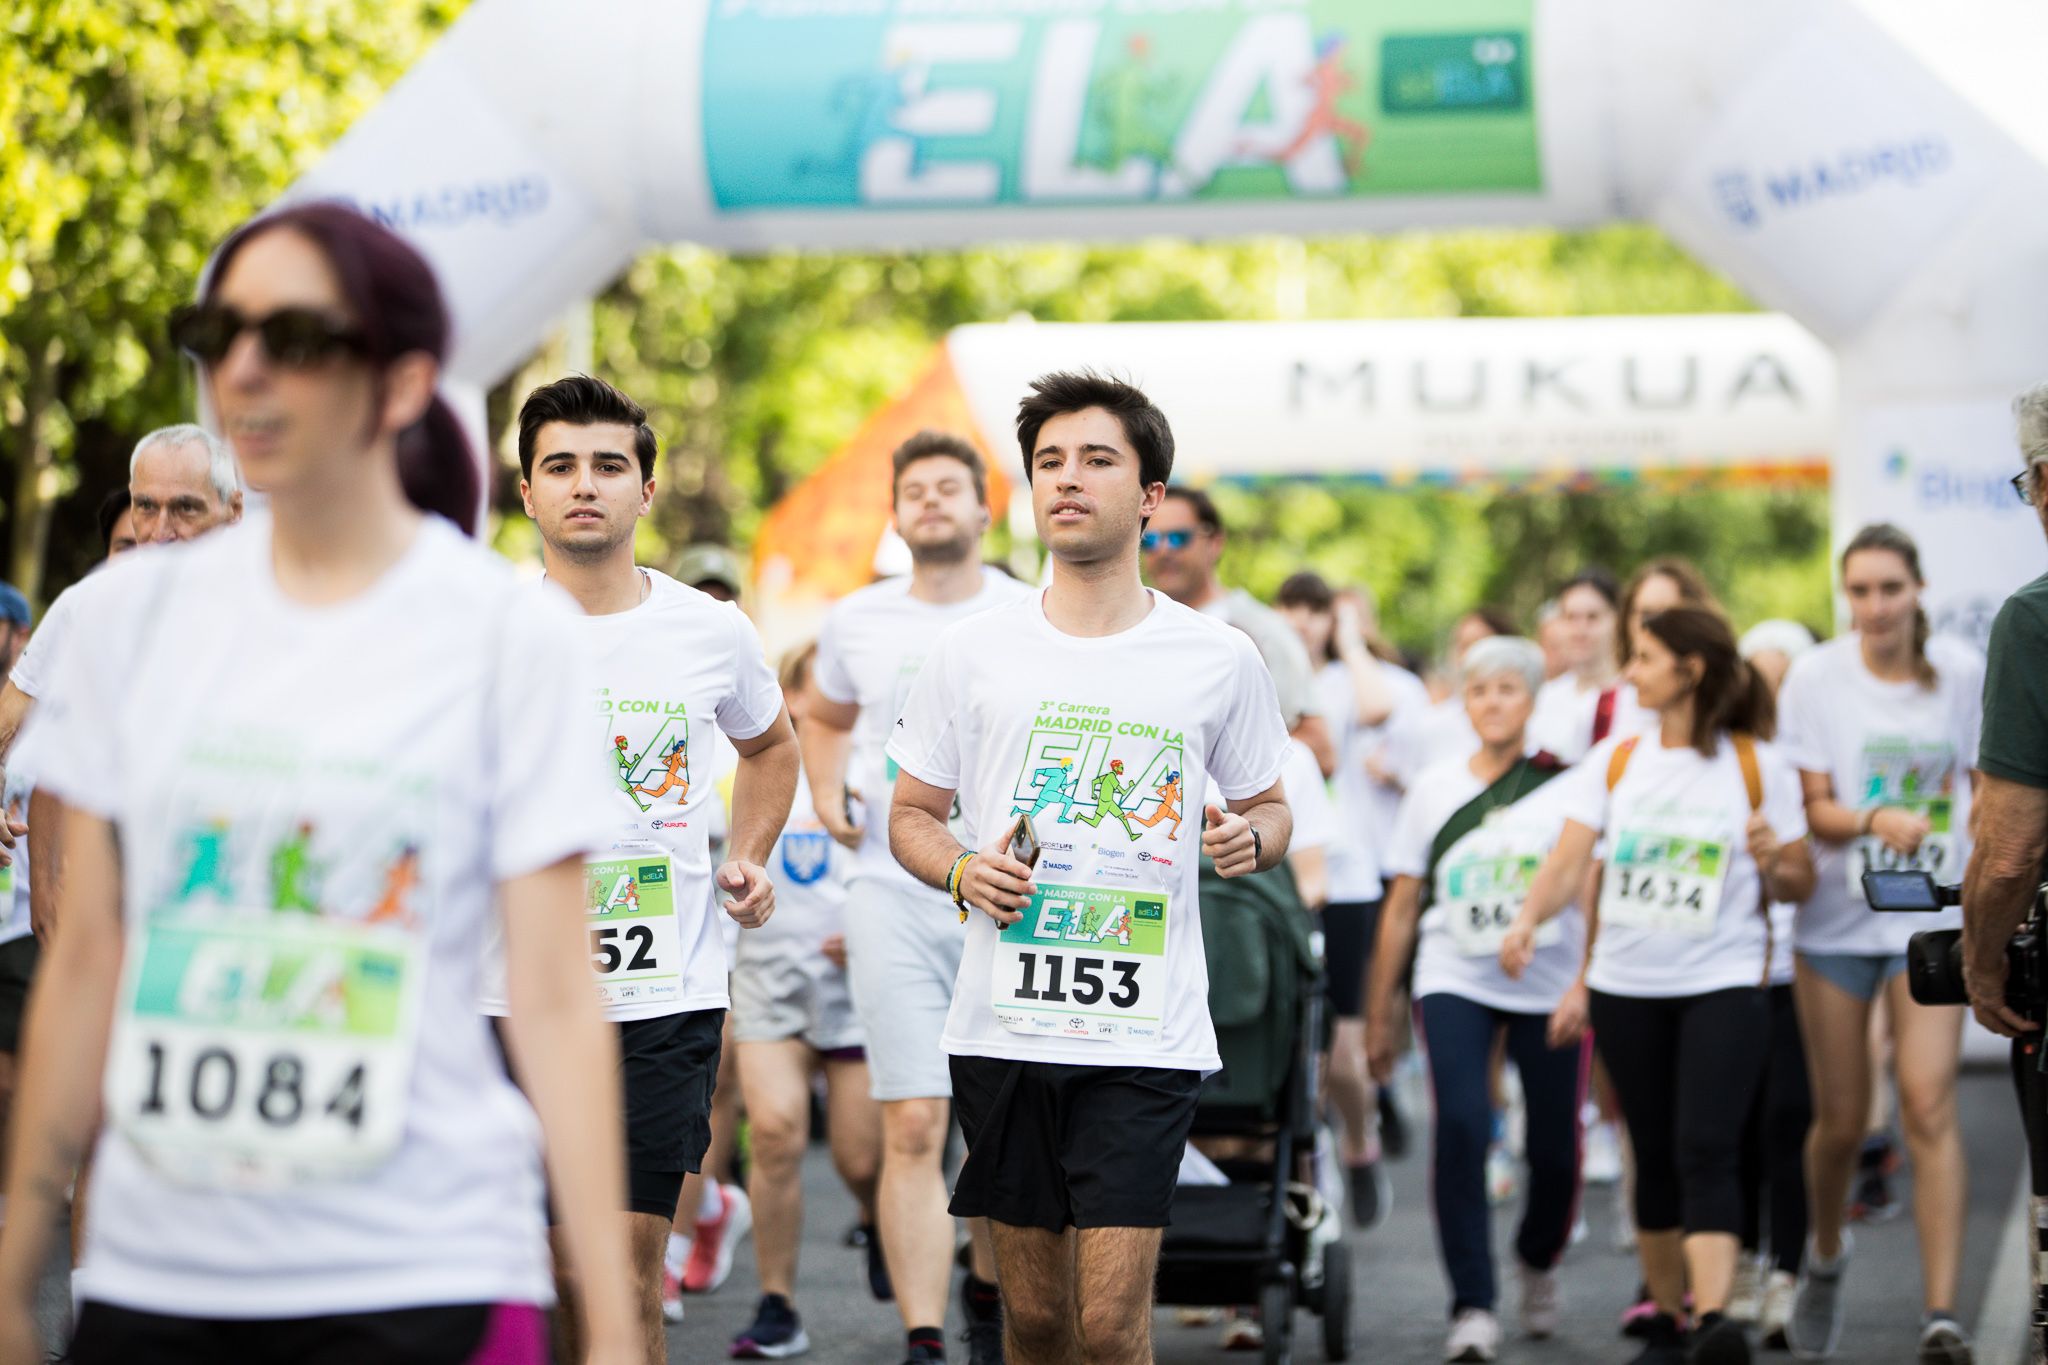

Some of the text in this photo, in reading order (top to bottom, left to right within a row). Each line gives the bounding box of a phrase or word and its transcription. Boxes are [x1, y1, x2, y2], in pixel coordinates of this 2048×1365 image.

[860, 12, 1350, 203] ELA
[1290, 352, 1806, 418] MUKUA
[618, 700, 659, 713] CON
[664, 702, 686, 715] LA
[1058, 702, 1110, 715] Carrera
[1034, 715, 1184, 745] MADRID CON LA
[1013, 730, 1184, 821] ELA
[592, 866, 614, 875] CON
[616, 864, 629, 873] LA
[1048, 862, 1073, 871] MADRID
[1098, 847, 1125, 858] Biogen
[1044, 888, 1086, 900] MADRID
[1088, 892, 1111, 902] CON
[1113, 895, 1126, 903] LA
[1620, 870, 1703, 912] 1634
[1033, 898, 1130, 946] ELA
[591, 925, 657, 973] 52
[1014, 952, 1142, 1009] 1153
[141, 1040, 365, 1128] 1084
